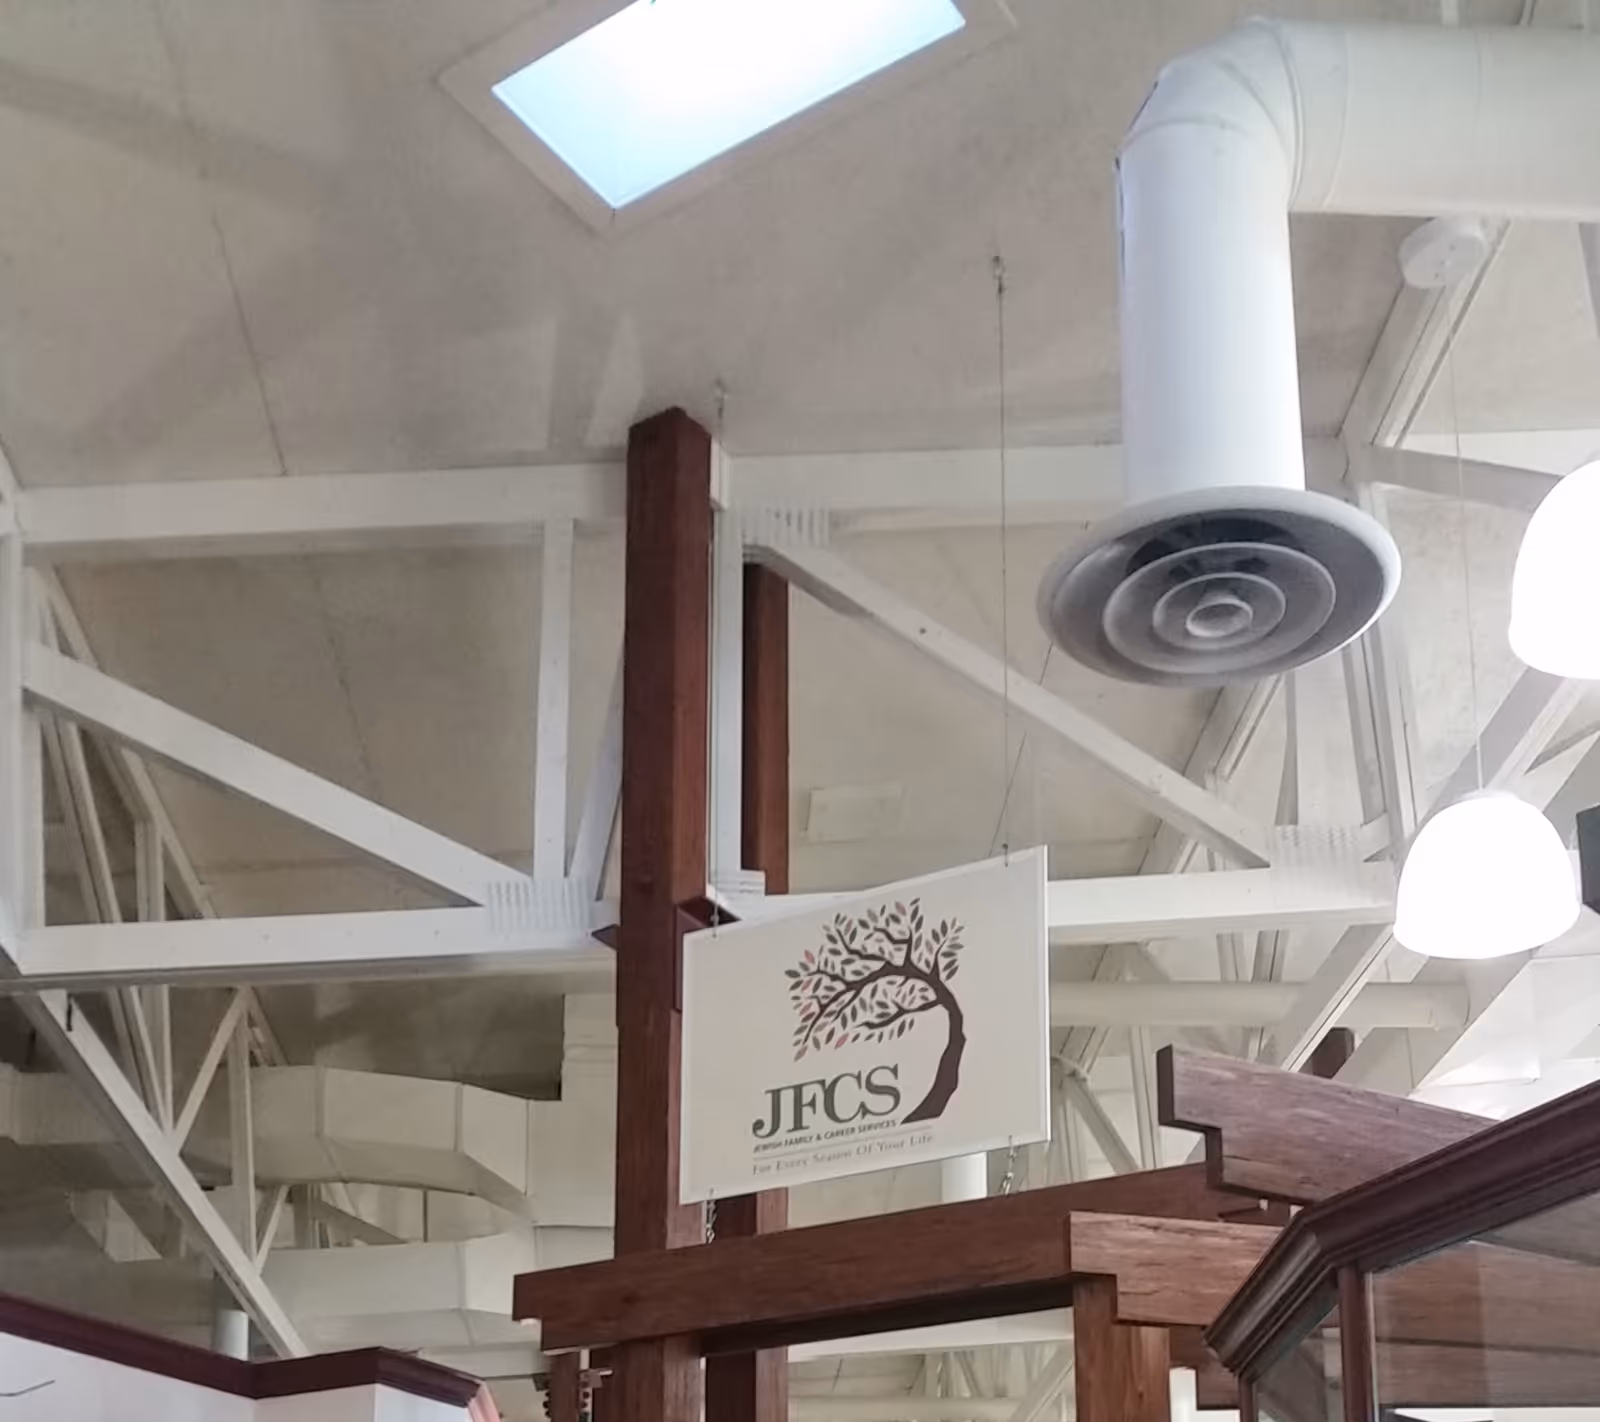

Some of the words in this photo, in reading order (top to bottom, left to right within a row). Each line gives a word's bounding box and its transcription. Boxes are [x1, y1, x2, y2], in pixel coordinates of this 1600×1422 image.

[752, 1063, 902, 1139] JFCS
[753, 1142, 783, 1153] JEWISH
[784, 1135, 813, 1147] FAMILY
[815, 1132, 822, 1141] &
[824, 1126, 856, 1139] CAREER
[857, 1118, 897, 1134] SERVICES
[753, 1163, 772, 1176] For
[776, 1157, 807, 1172] Every
[812, 1149, 852, 1163] Season
[876, 1140, 905, 1152] Your
[910, 1133, 934, 1147] Life
